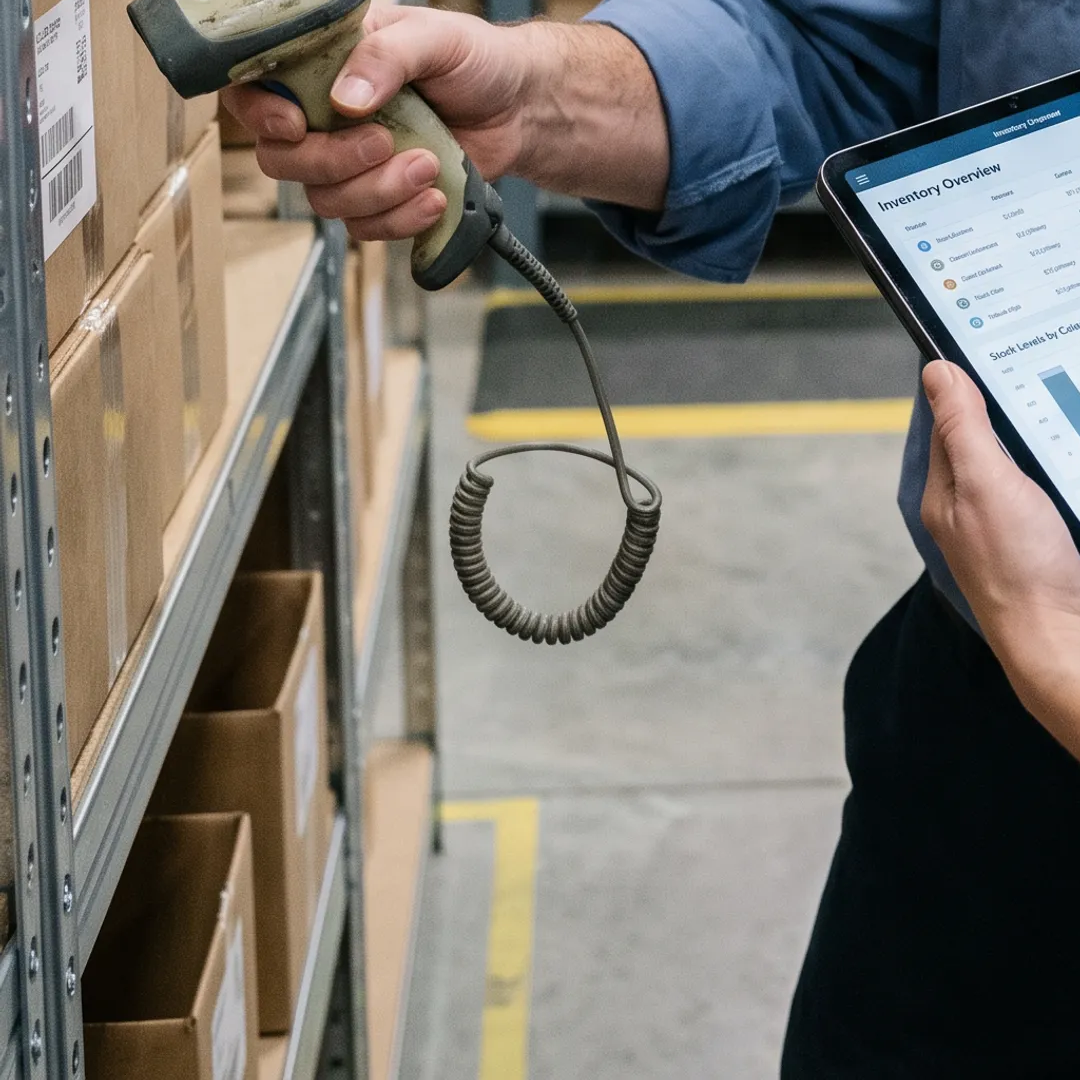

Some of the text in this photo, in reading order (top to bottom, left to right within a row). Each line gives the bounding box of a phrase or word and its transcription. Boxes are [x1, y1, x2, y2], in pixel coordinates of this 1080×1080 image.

[877, 162, 1001, 212] Inventory Overview
[1045, 331, 1058, 341] by
